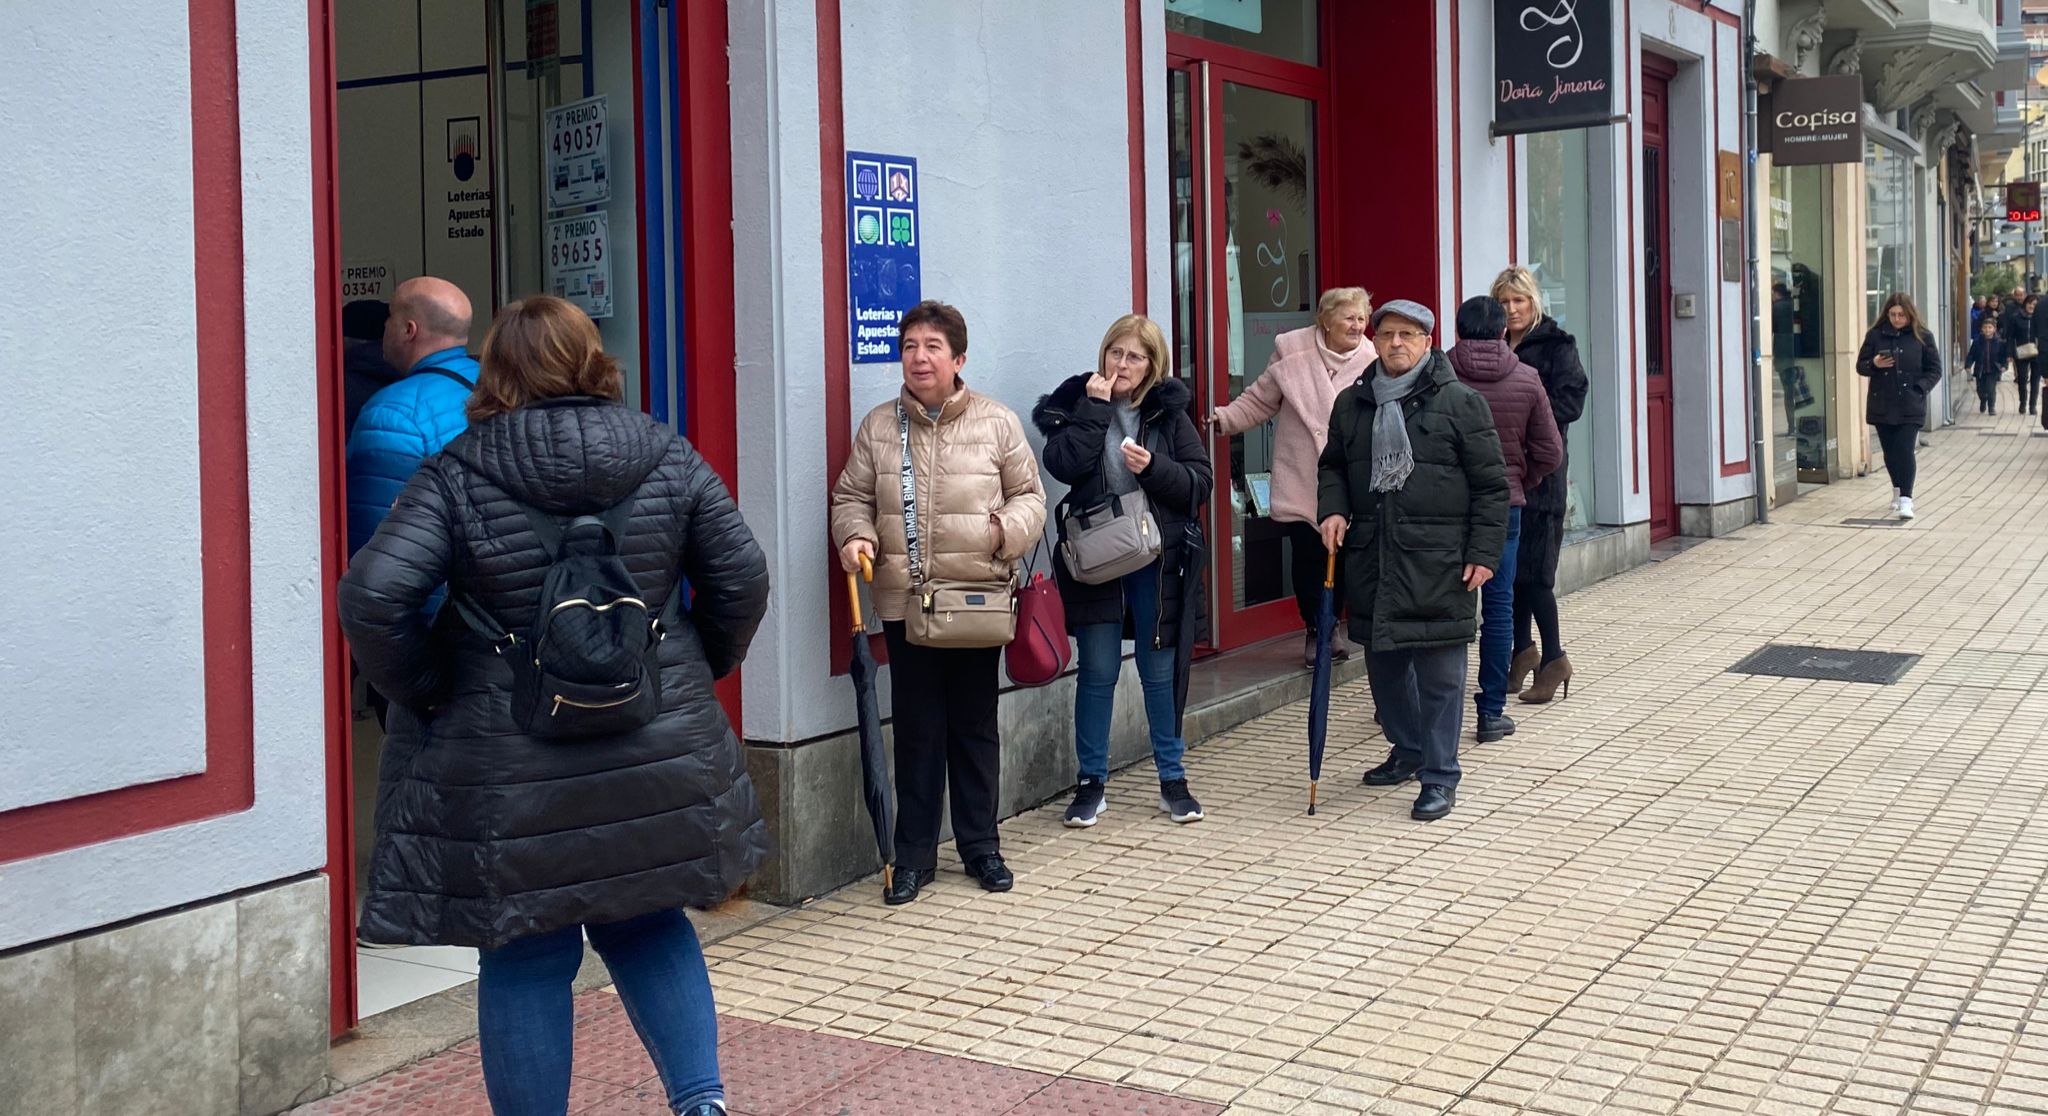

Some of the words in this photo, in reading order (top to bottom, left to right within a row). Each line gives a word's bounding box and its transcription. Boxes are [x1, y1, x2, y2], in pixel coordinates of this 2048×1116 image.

[1500, 79, 1543, 103] Doña
[1548, 75, 1606, 104] Jimena
[566, 105, 598, 127] PREMIO
[553, 122, 602, 155] 49057
[1784, 135, 1817, 143] HOMBRE
[1822, 133, 1848, 141] MUJER
[448, 207, 491, 223] Apuesta
[2023, 210, 2039, 220] LA
[448, 225, 484, 239] Estado
[565, 220, 597, 239] PREMIO
[552, 238, 602, 267] 89655
[347, 266, 386, 280] PREMIO
[343, 282, 381, 297] 03347
[857, 306, 895, 321] Loterías
[896, 310, 903, 324] y
[858, 324, 901, 341] Apuestas
[858, 340, 890, 355] Estado
[902, 466, 914, 501] BIMBA
[904, 501, 918, 539] BIMBA
